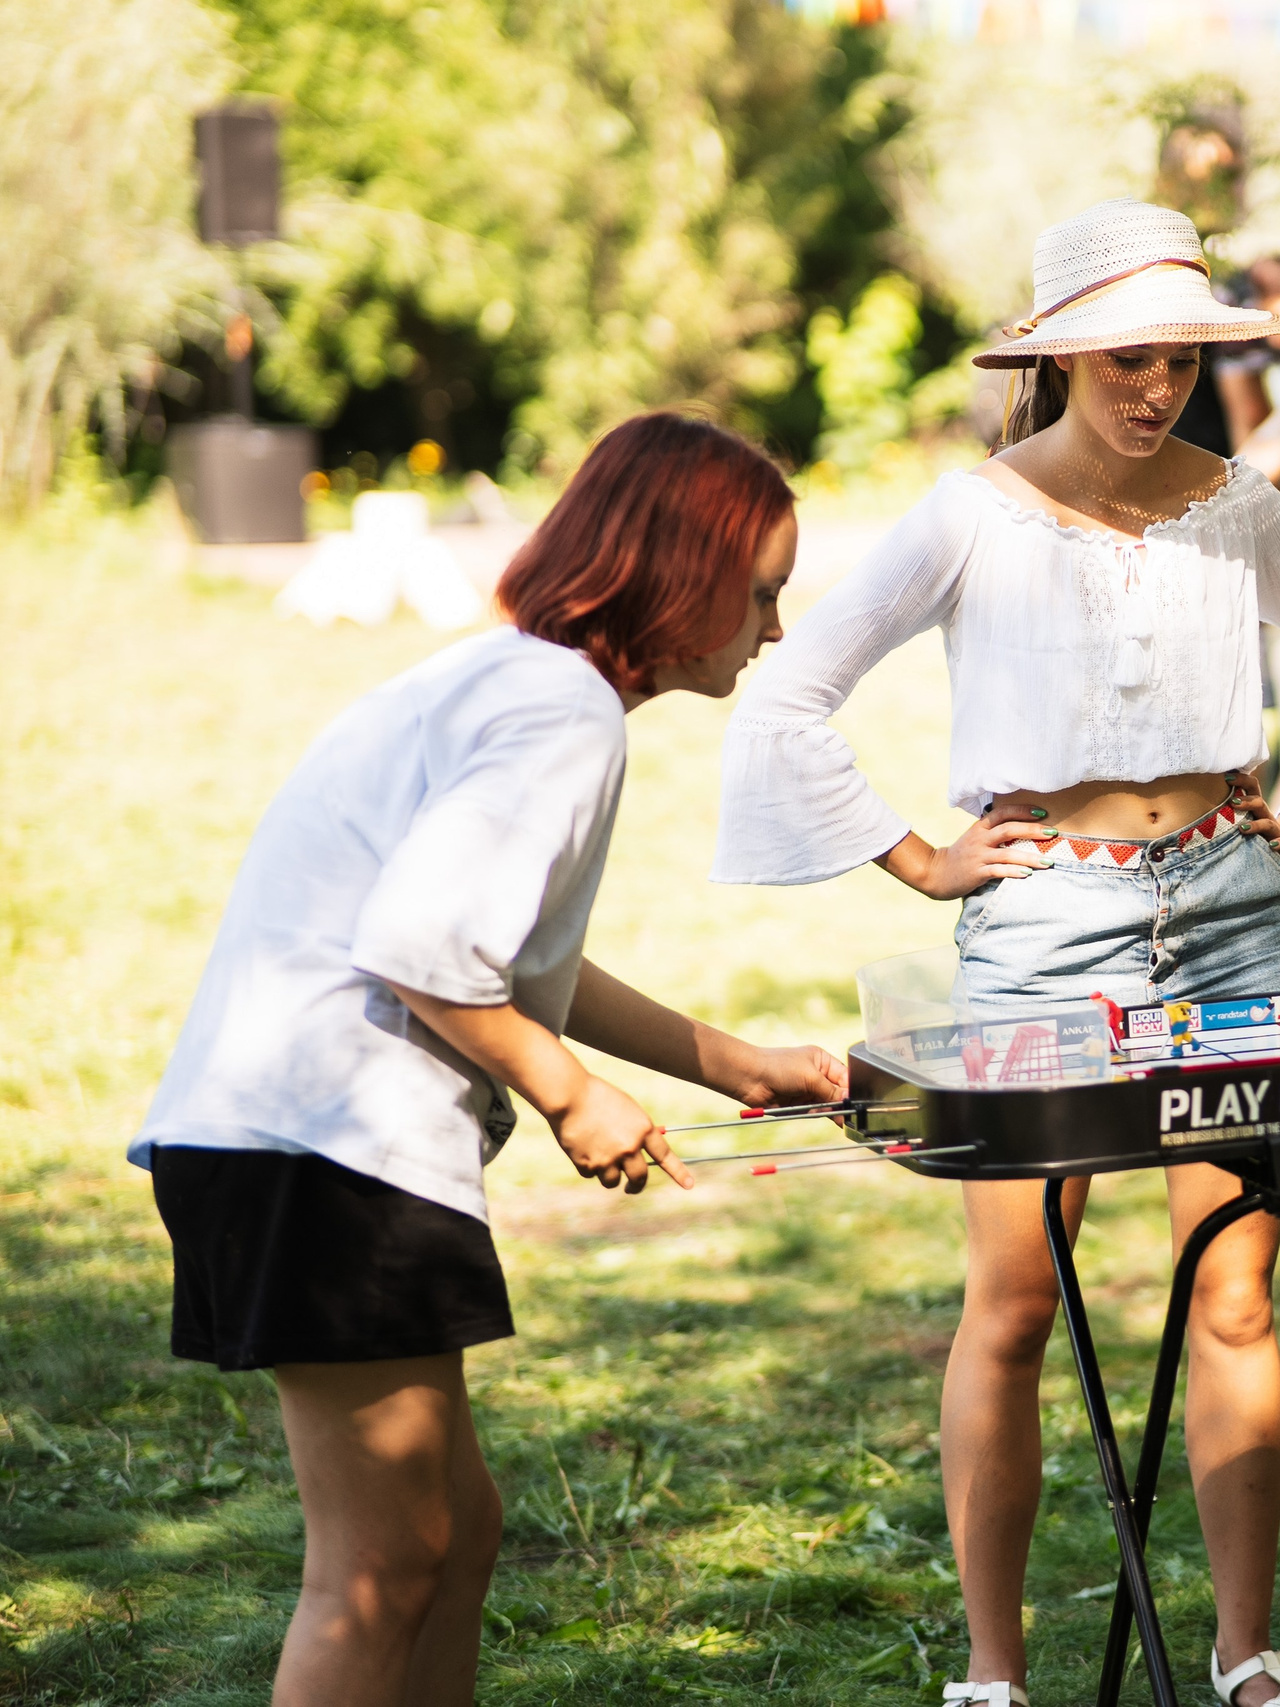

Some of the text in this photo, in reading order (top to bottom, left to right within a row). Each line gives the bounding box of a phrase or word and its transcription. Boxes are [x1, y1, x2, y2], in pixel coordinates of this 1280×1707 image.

[1132, 1011, 1163, 1024] LIQUI
[1217, 1009, 1249, 1020] randstad
[1132, 1021, 1163, 1034] MOLY
[1160, 1079, 1271, 1132] PLAY
